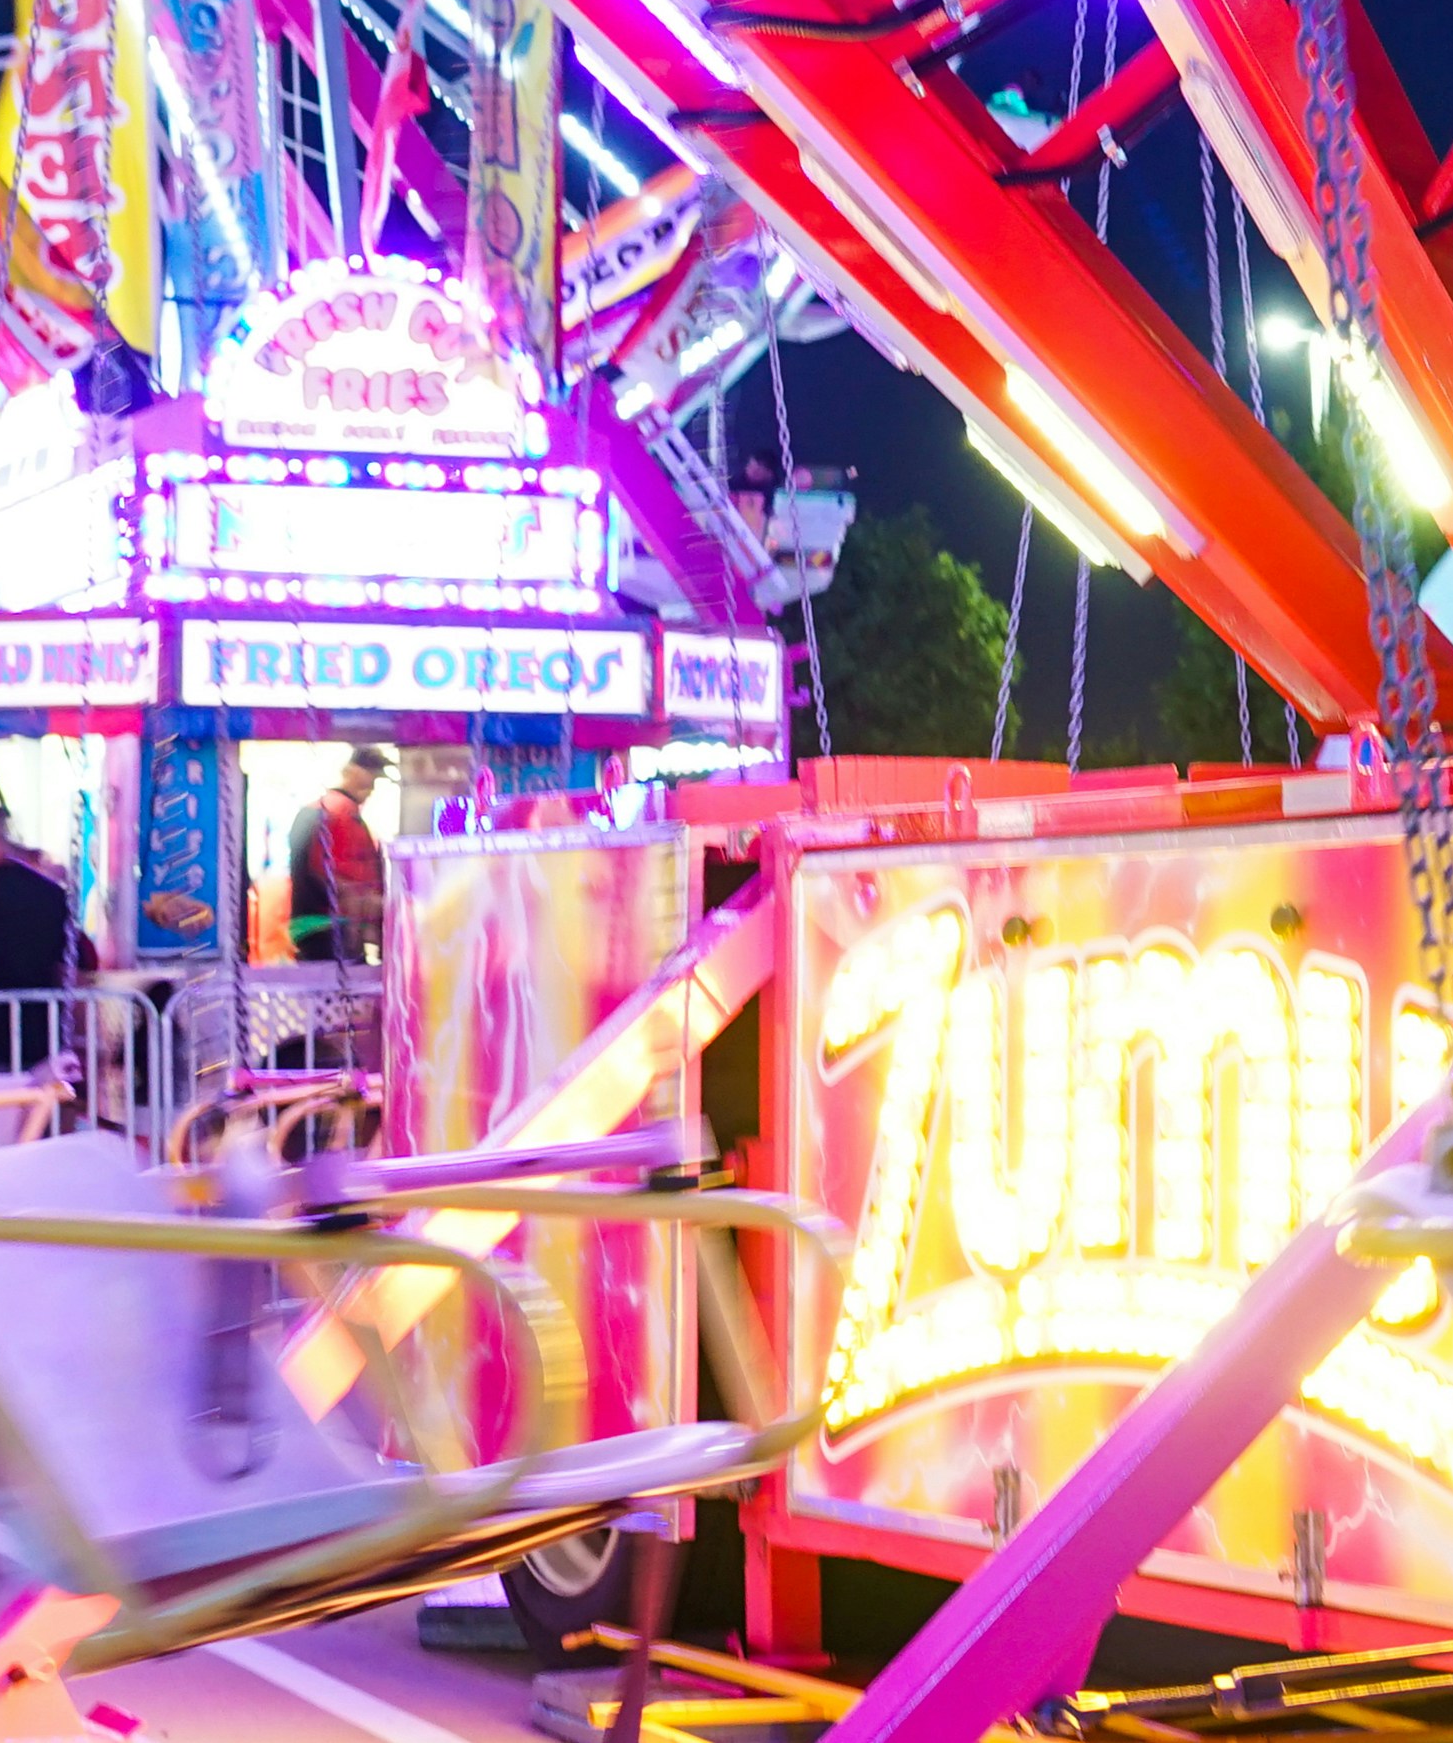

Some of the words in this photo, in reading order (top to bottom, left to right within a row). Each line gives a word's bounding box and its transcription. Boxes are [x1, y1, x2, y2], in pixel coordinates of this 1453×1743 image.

[303, 367, 449, 416] FRIES
[207, 638, 391, 686] FRIED
[412, 644, 624, 695] OREOS
